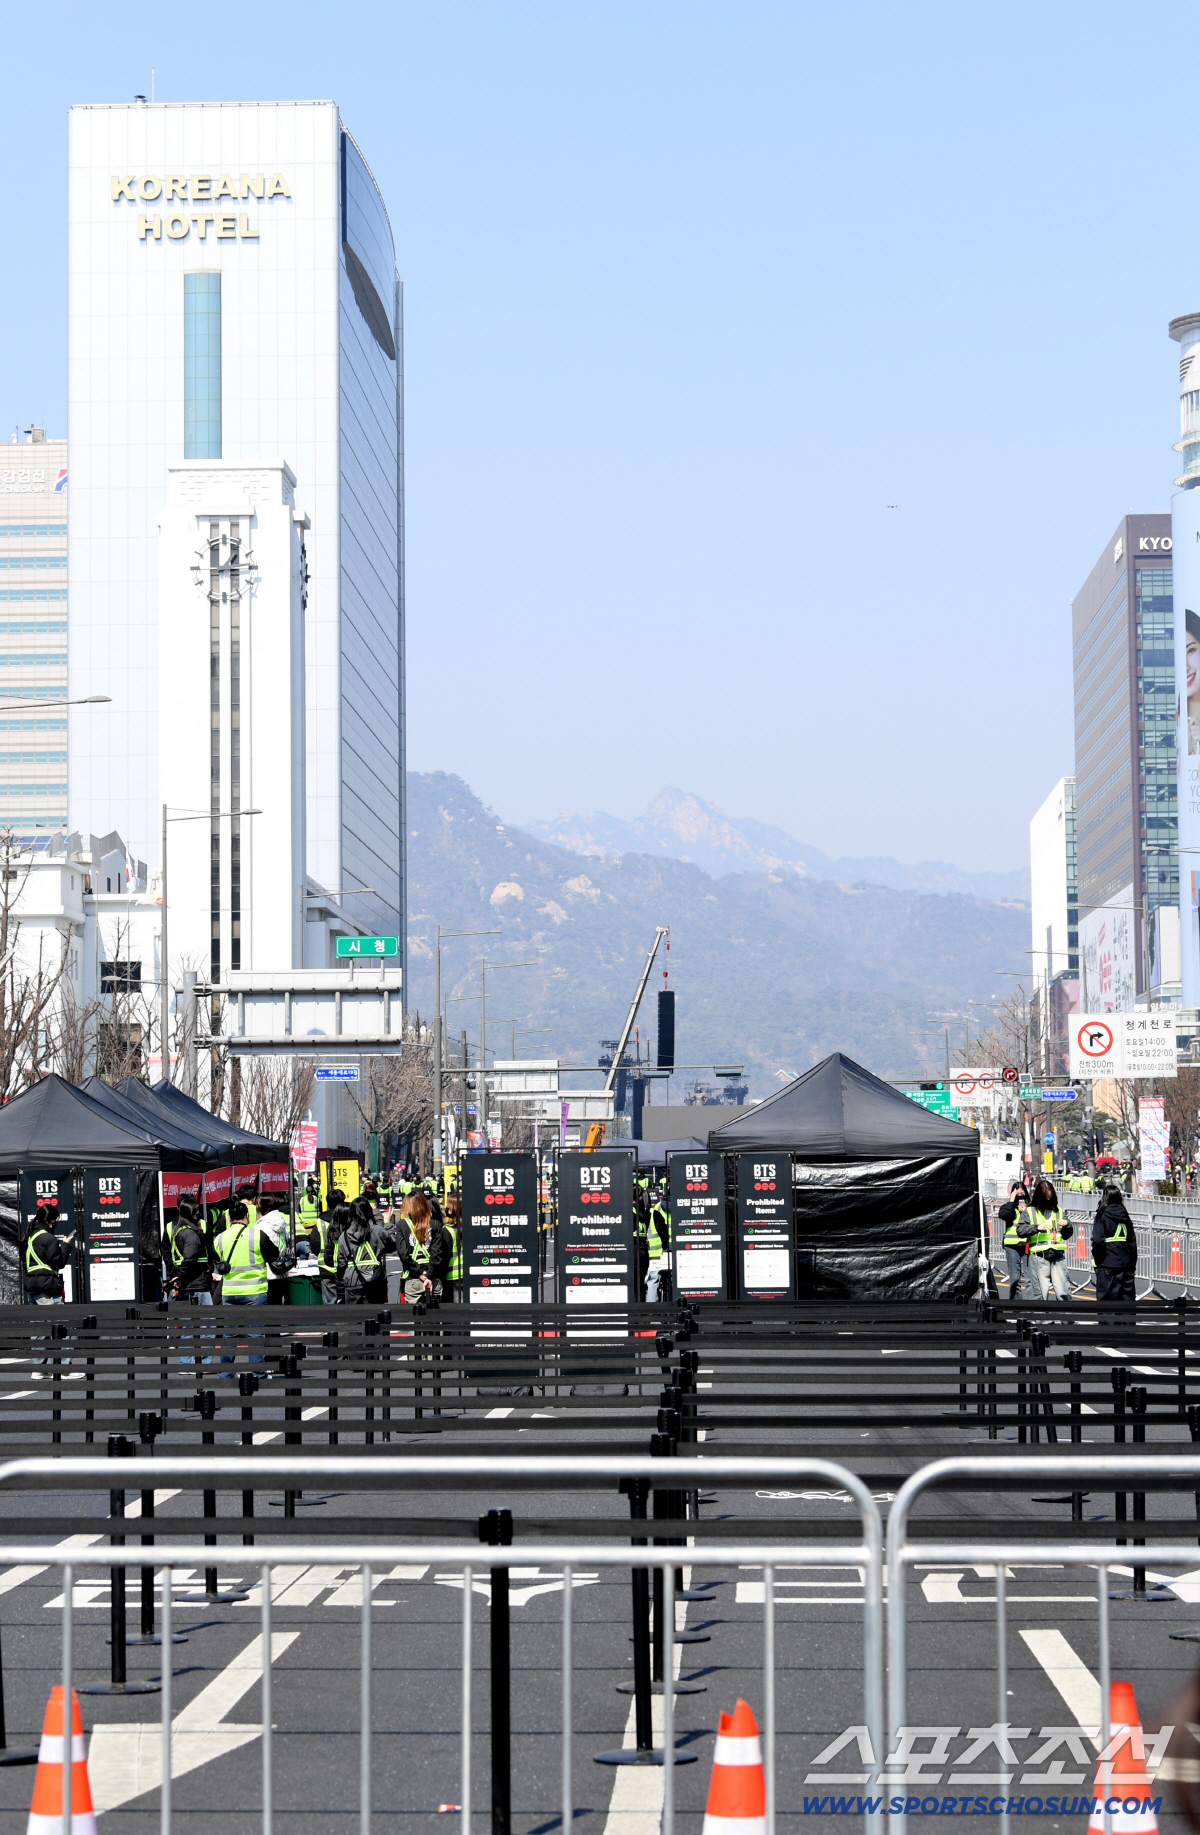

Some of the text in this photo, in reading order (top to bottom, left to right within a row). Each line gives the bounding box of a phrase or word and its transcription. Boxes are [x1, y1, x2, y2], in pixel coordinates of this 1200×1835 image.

[111, 173, 291, 200] KOREANA
[138, 213, 260, 239] HOTEL
[0, 469, 45, 484] 강검진
[348, 940, 385, 953] 시청
[1125, 1020, 1172, 1030] 청계천로
[1079, 1060, 1114, 1068] 전방300m
[484, 1168, 514, 1186] BTS
[580, 1167, 610, 1184] BTS
[685, 1164, 708, 1177] BTS
[753, 1164, 776, 1177] BTS
[36, 1180, 58, 1193] BTS
[99, 1178, 121, 1191] BTS
[677, 1198, 691, 1206] 반입
[746, 1198, 784, 1206] Prohibited
[92, 1212, 130, 1220] Prohibited
[471, 1215, 528, 1226] 반입 금지물품
[570, 1215, 622, 1224] Prohibited
[490, 1227, 509, 1237] 안내
[582, 1227, 610, 1236] Items
